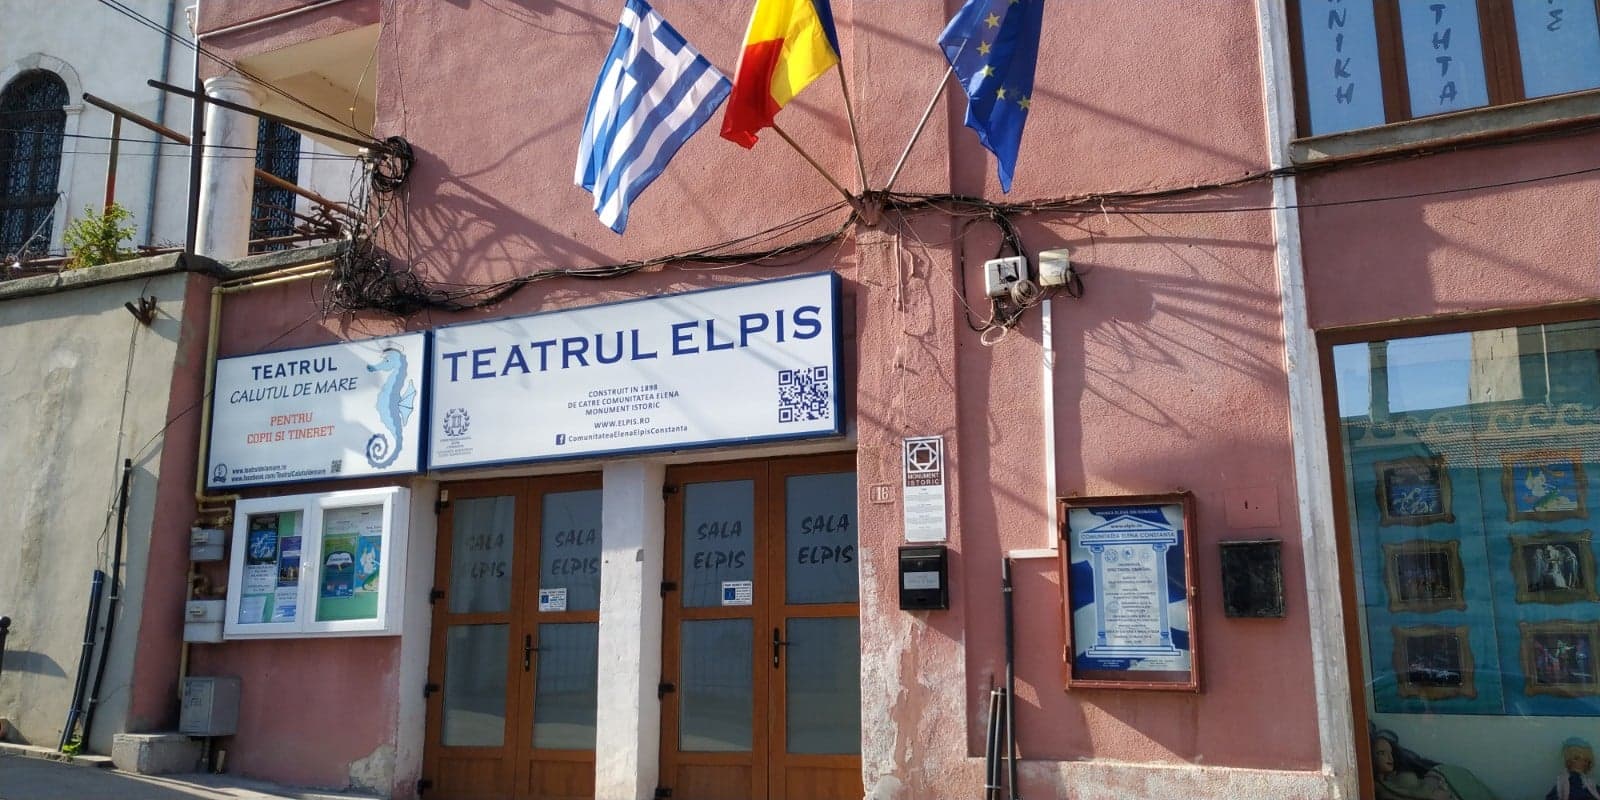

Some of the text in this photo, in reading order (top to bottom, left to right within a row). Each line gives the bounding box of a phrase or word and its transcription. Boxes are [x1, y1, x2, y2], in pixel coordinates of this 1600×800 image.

[442, 305, 822, 382] TEATRUL ELPIS
[251, 357, 338, 381] TEATRUL
[230, 377, 359, 404] CALUTUL DE MARE
[578, 399, 600, 408] CATRE
[601, 393, 655, 406] COMUNITATEA
[656, 390, 680, 399] ELENA
[588, 386, 629, 398] CONSTRUIT
[640, 383, 658, 392] 1898
[585, 401, 660, 416] MONUMENT ISTORIC
[270, 411, 313, 427] PENTRU
[593, 417, 650, 429] WWW.ELPIS.RO
[246, 425, 336, 445] COPII SI TINERET
[907, 472, 939, 480] MONUMENT
[696, 520, 743, 541] SALA
[801, 513, 850, 535] SALA
[554, 528, 597, 548] SALA
[693, 550, 746, 570] ELPIS
[797, 544, 854, 565] ELPIS
[551, 557, 599, 576] ELPIS
